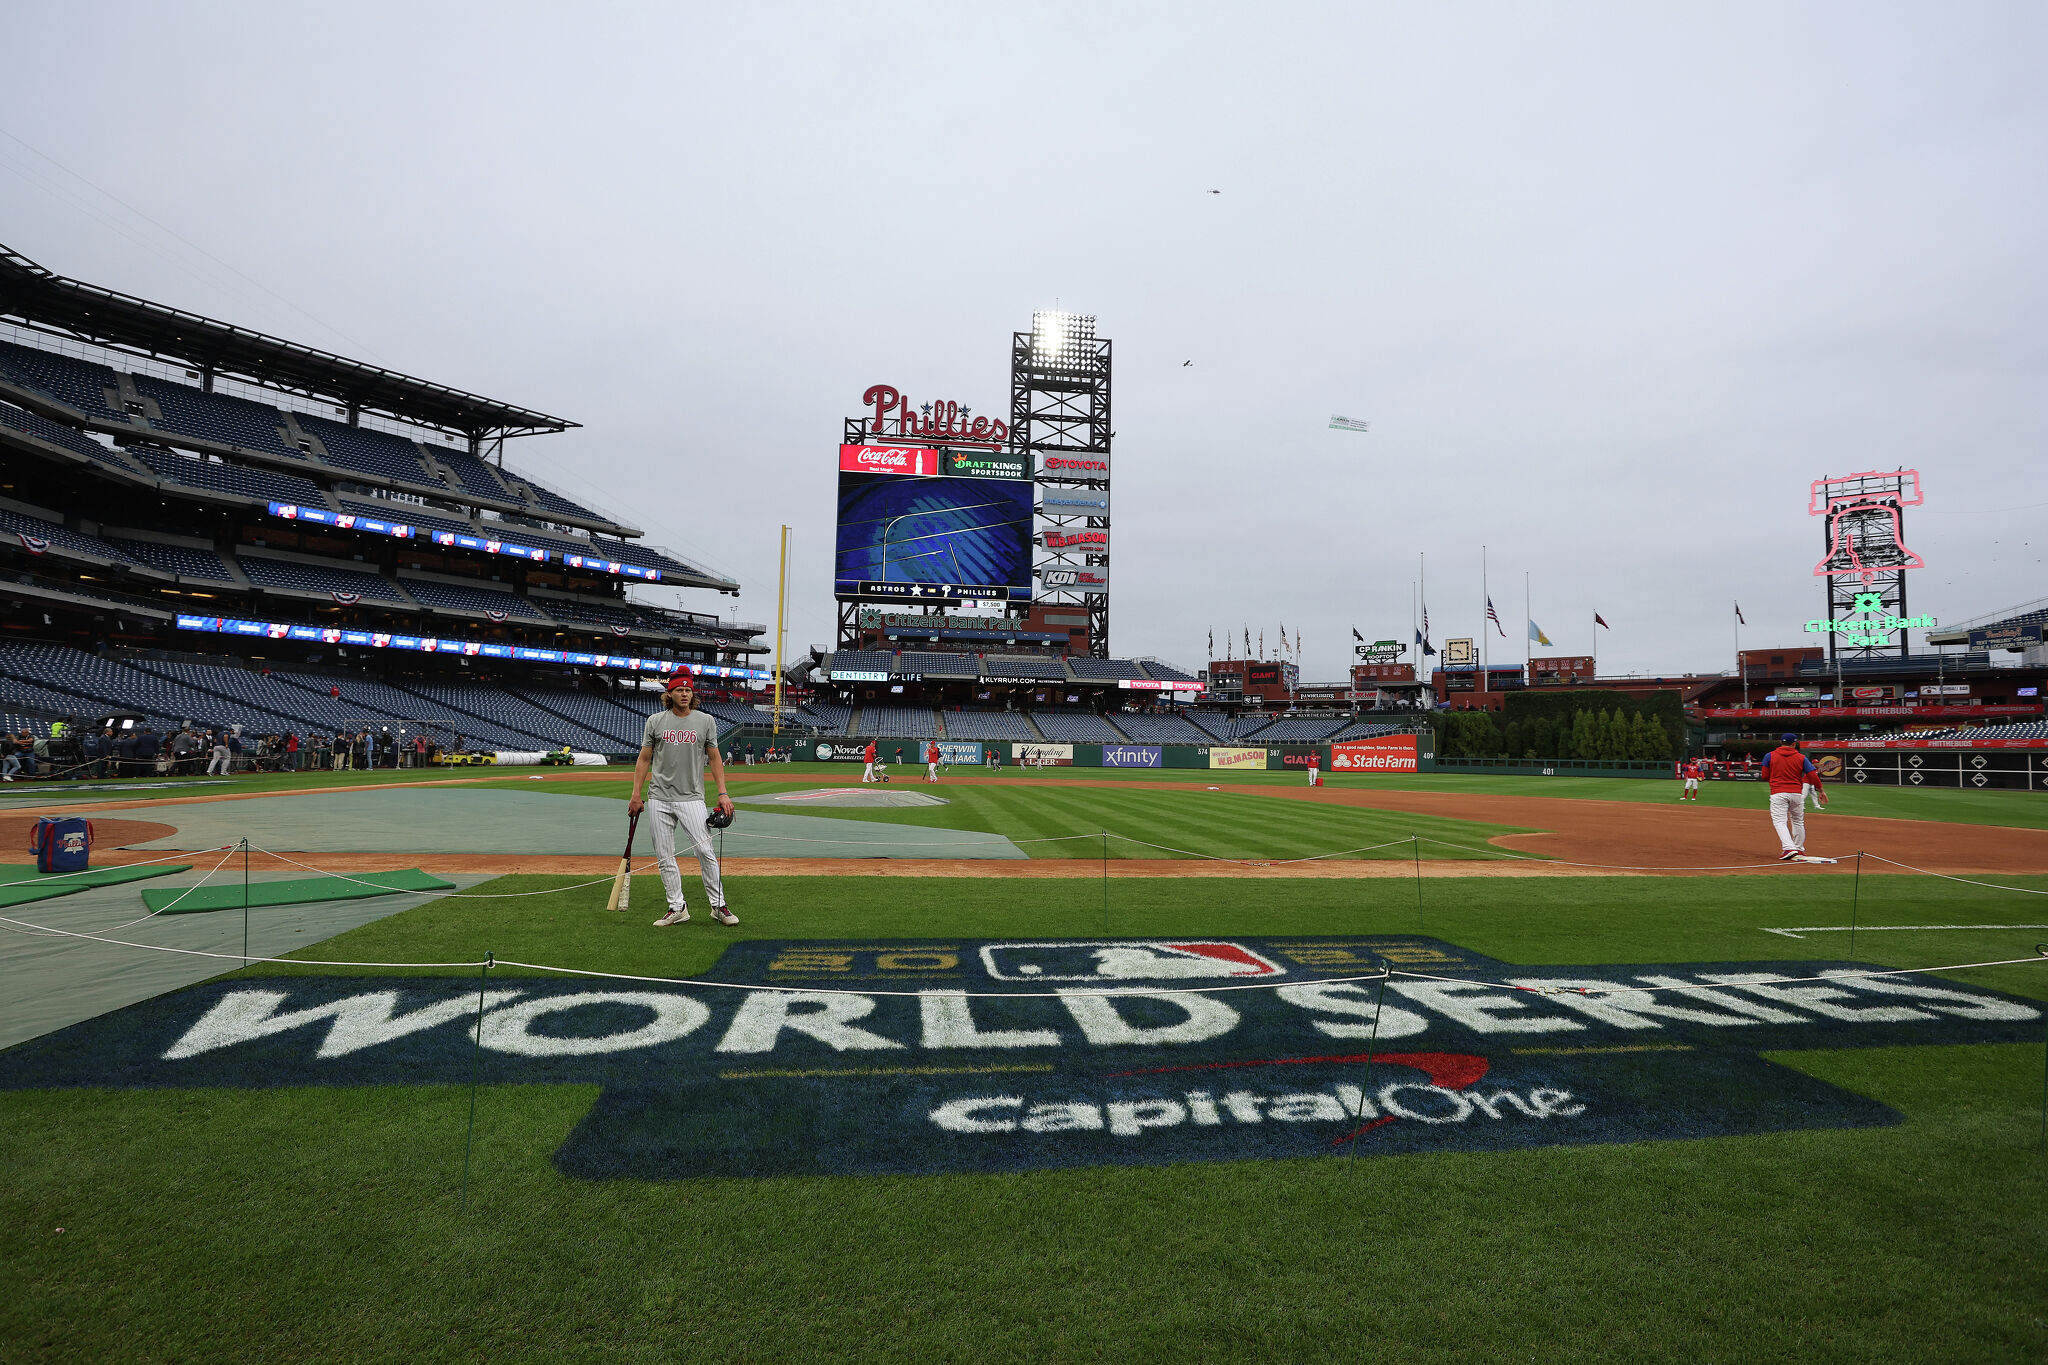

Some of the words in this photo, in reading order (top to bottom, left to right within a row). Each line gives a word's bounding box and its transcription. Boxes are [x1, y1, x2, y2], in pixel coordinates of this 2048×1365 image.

[863, 384, 1009, 441] Phillies
[955, 460, 1022, 470] DRAFTKINGS
[1061, 459, 1107, 470] TOYOTA
[971, 469, 1022, 477] SPORTSBOOK
[1047, 571, 1077, 585] KDI
[870, 585, 905, 593] ASTROS
[957, 588, 997, 596] PHILLIES
[884, 613, 945, 629] Citizens
[948, 615, 986, 630] Bank
[989, 618, 1022, 631] Park
[1806, 619, 1882, 633] Citizens
[1885, 614, 1935, 629] Bank
[1848, 632, 1890, 646] Park
[832, 671, 887, 680] DENTISTRY
[902, 674, 922, 682] LIFE
[1760, 708, 1810, 716] #HITTHEBUDS
[1856, 707, 1913, 715] #HITTHEBUDS
[833, 744, 866, 754] NovaCa
[937, 744, 977, 753] SHERWIN
[1928, 740, 1973, 748] #HITTHEBUDS
[1029, 758, 1056, 766] LGER
[1106, 748, 1158, 766] xfinity
[1542, 768, 1554, 776] 401
[160, 985, 1242, 1060] WORLD
[1275, 967, 2042, 1040] SERIES
